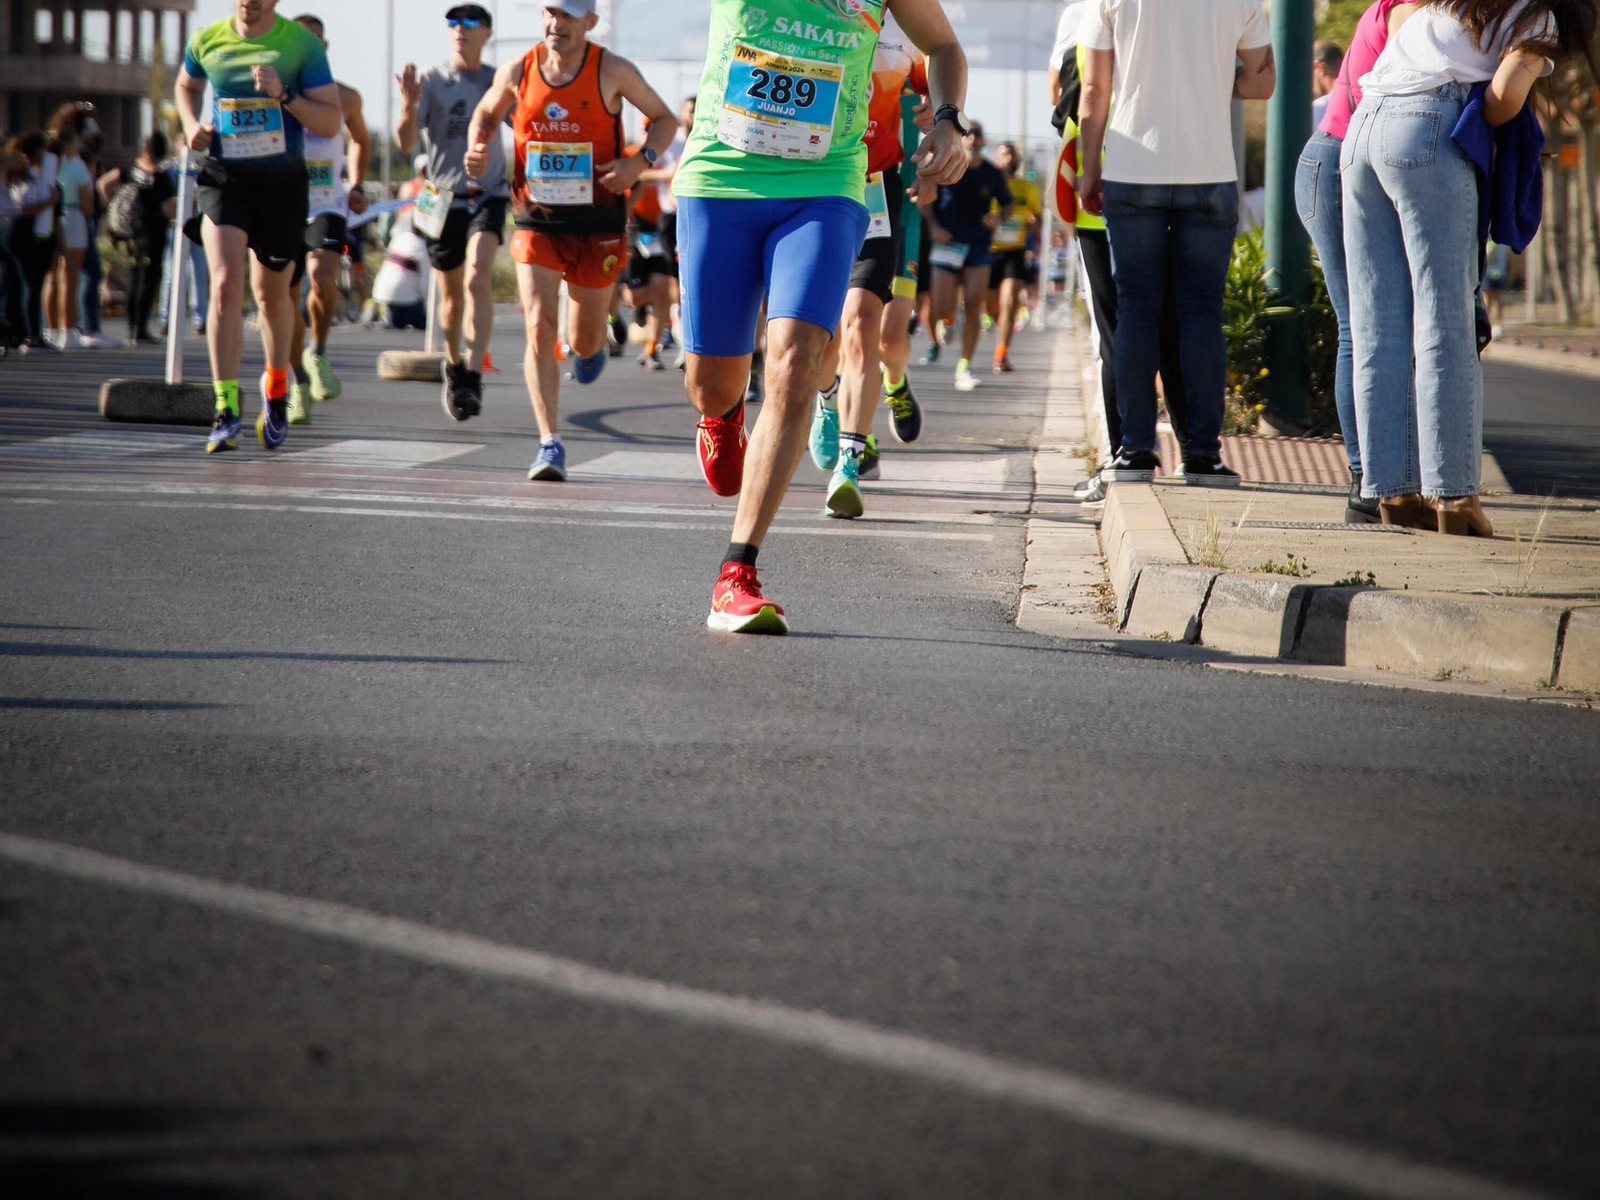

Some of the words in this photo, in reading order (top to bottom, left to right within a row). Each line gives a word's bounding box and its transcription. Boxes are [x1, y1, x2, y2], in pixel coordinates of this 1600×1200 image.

[773, 16, 859, 48] SAKATA
[788, 65, 805, 73] 2024
[747, 67, 816, 108] 289
[230, 108, 268, 127] 823
[757, 101, 796, 116] JUANJO
[531, 121, 580, 134] TARSO
[539, 153, 579, 172] 667
